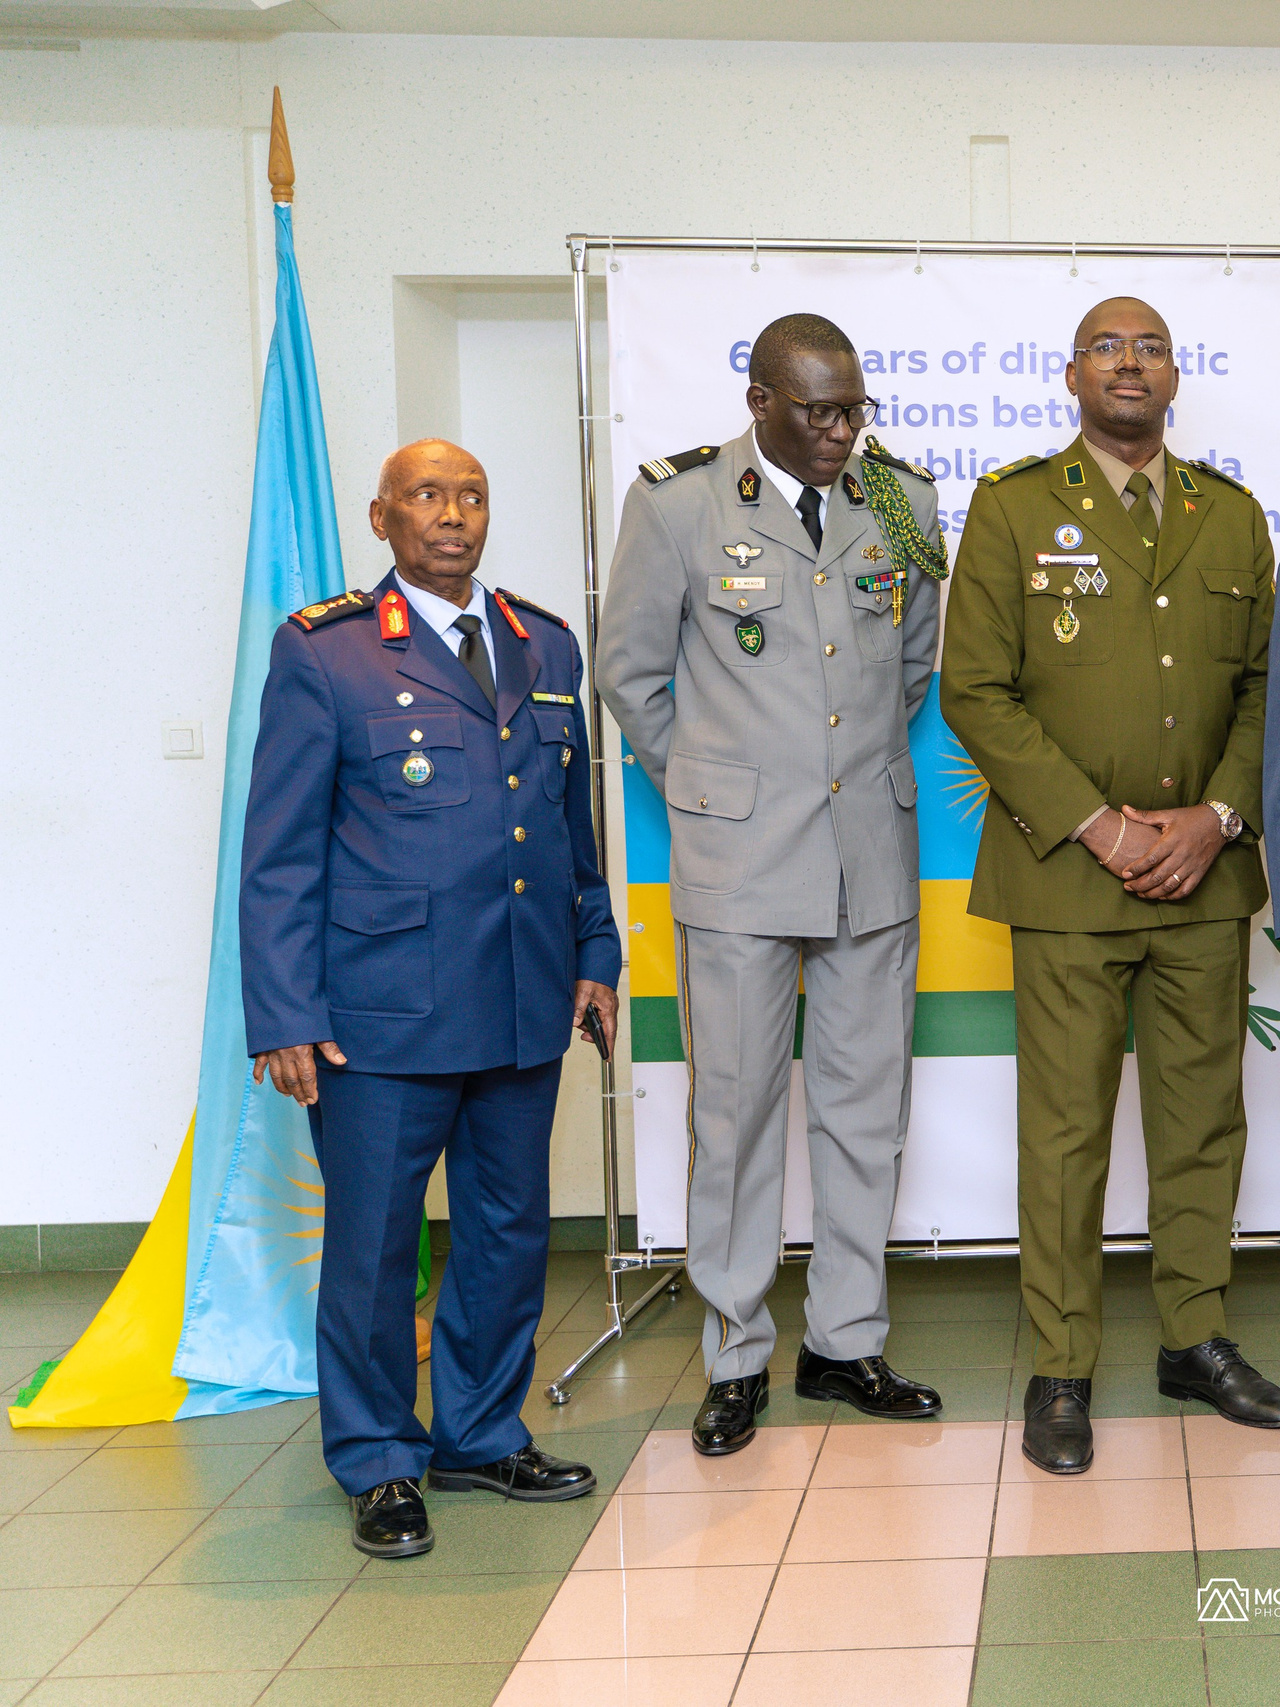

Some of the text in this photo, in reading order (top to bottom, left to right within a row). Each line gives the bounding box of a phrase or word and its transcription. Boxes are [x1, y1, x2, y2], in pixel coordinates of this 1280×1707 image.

[729, 340, 1229, 383] 6 ars of diptic
[873, 394, 979, 428] tions
